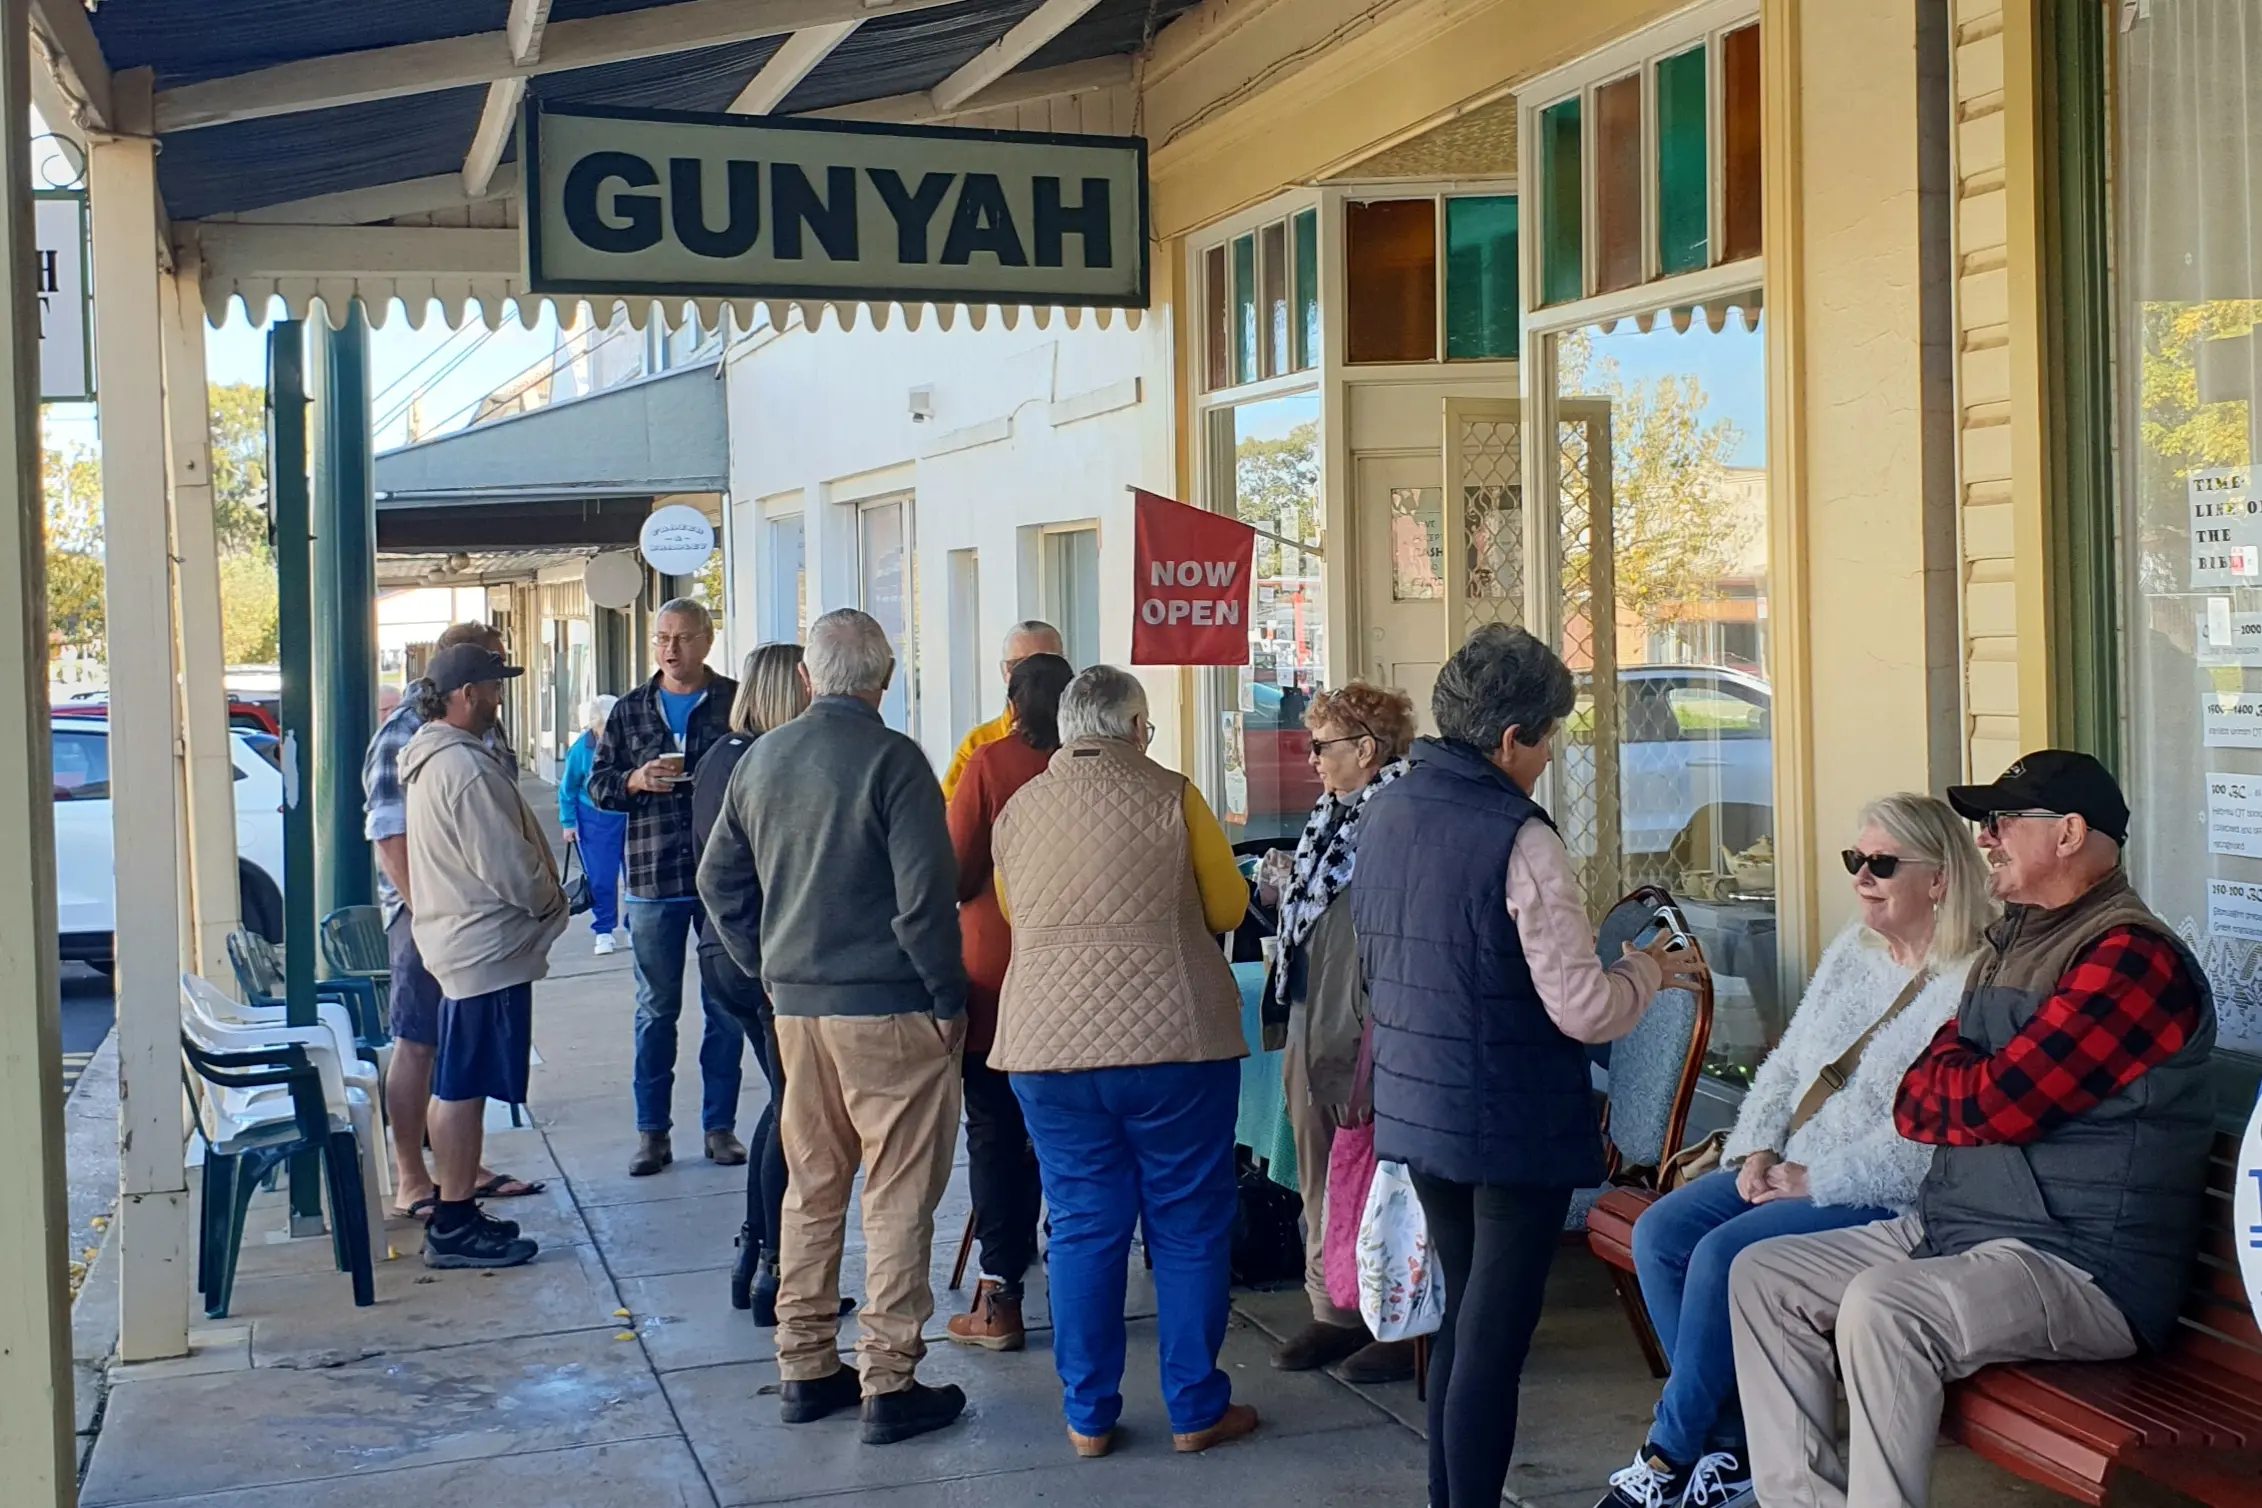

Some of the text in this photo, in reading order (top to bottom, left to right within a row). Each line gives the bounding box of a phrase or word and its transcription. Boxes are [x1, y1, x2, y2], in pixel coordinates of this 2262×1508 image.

[562, 151, 1112, 268] GUNYAH
[2195, 503, 2236, 517] LINE
[2196, 529, 2231, 543] THE
[1151, 560, 1237, 587] NOW
[1142, 599, 1239, 626] OPEN
